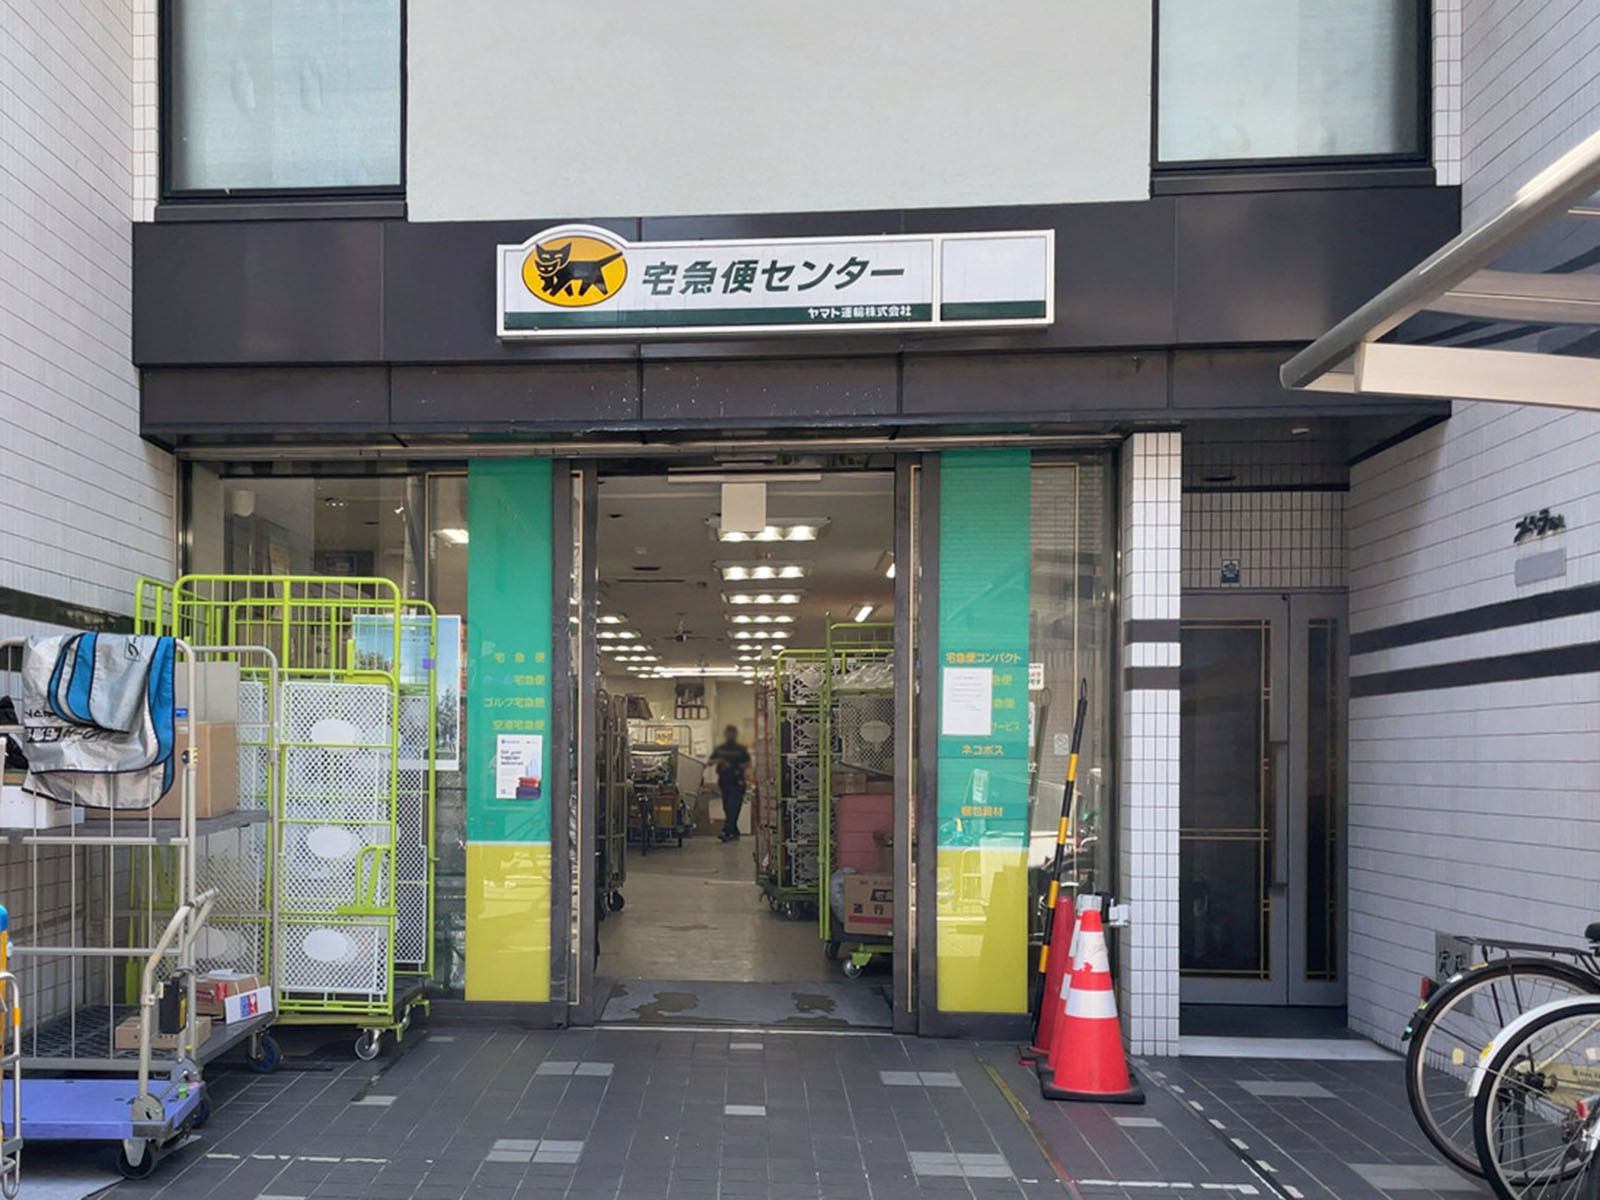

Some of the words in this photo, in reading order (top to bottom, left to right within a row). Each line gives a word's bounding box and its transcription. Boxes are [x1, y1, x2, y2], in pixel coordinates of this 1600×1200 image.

[642, 256, 905, 296] 宅急便センター
[807, 304, 912, 319] ヤマト運輸株式会社
[945, 652, 1022, 664] 宅急便コンパクト
[484, 697, 545, 708] ゴルフ宅急便
[962, 744, 1004, 756] ネコポス
